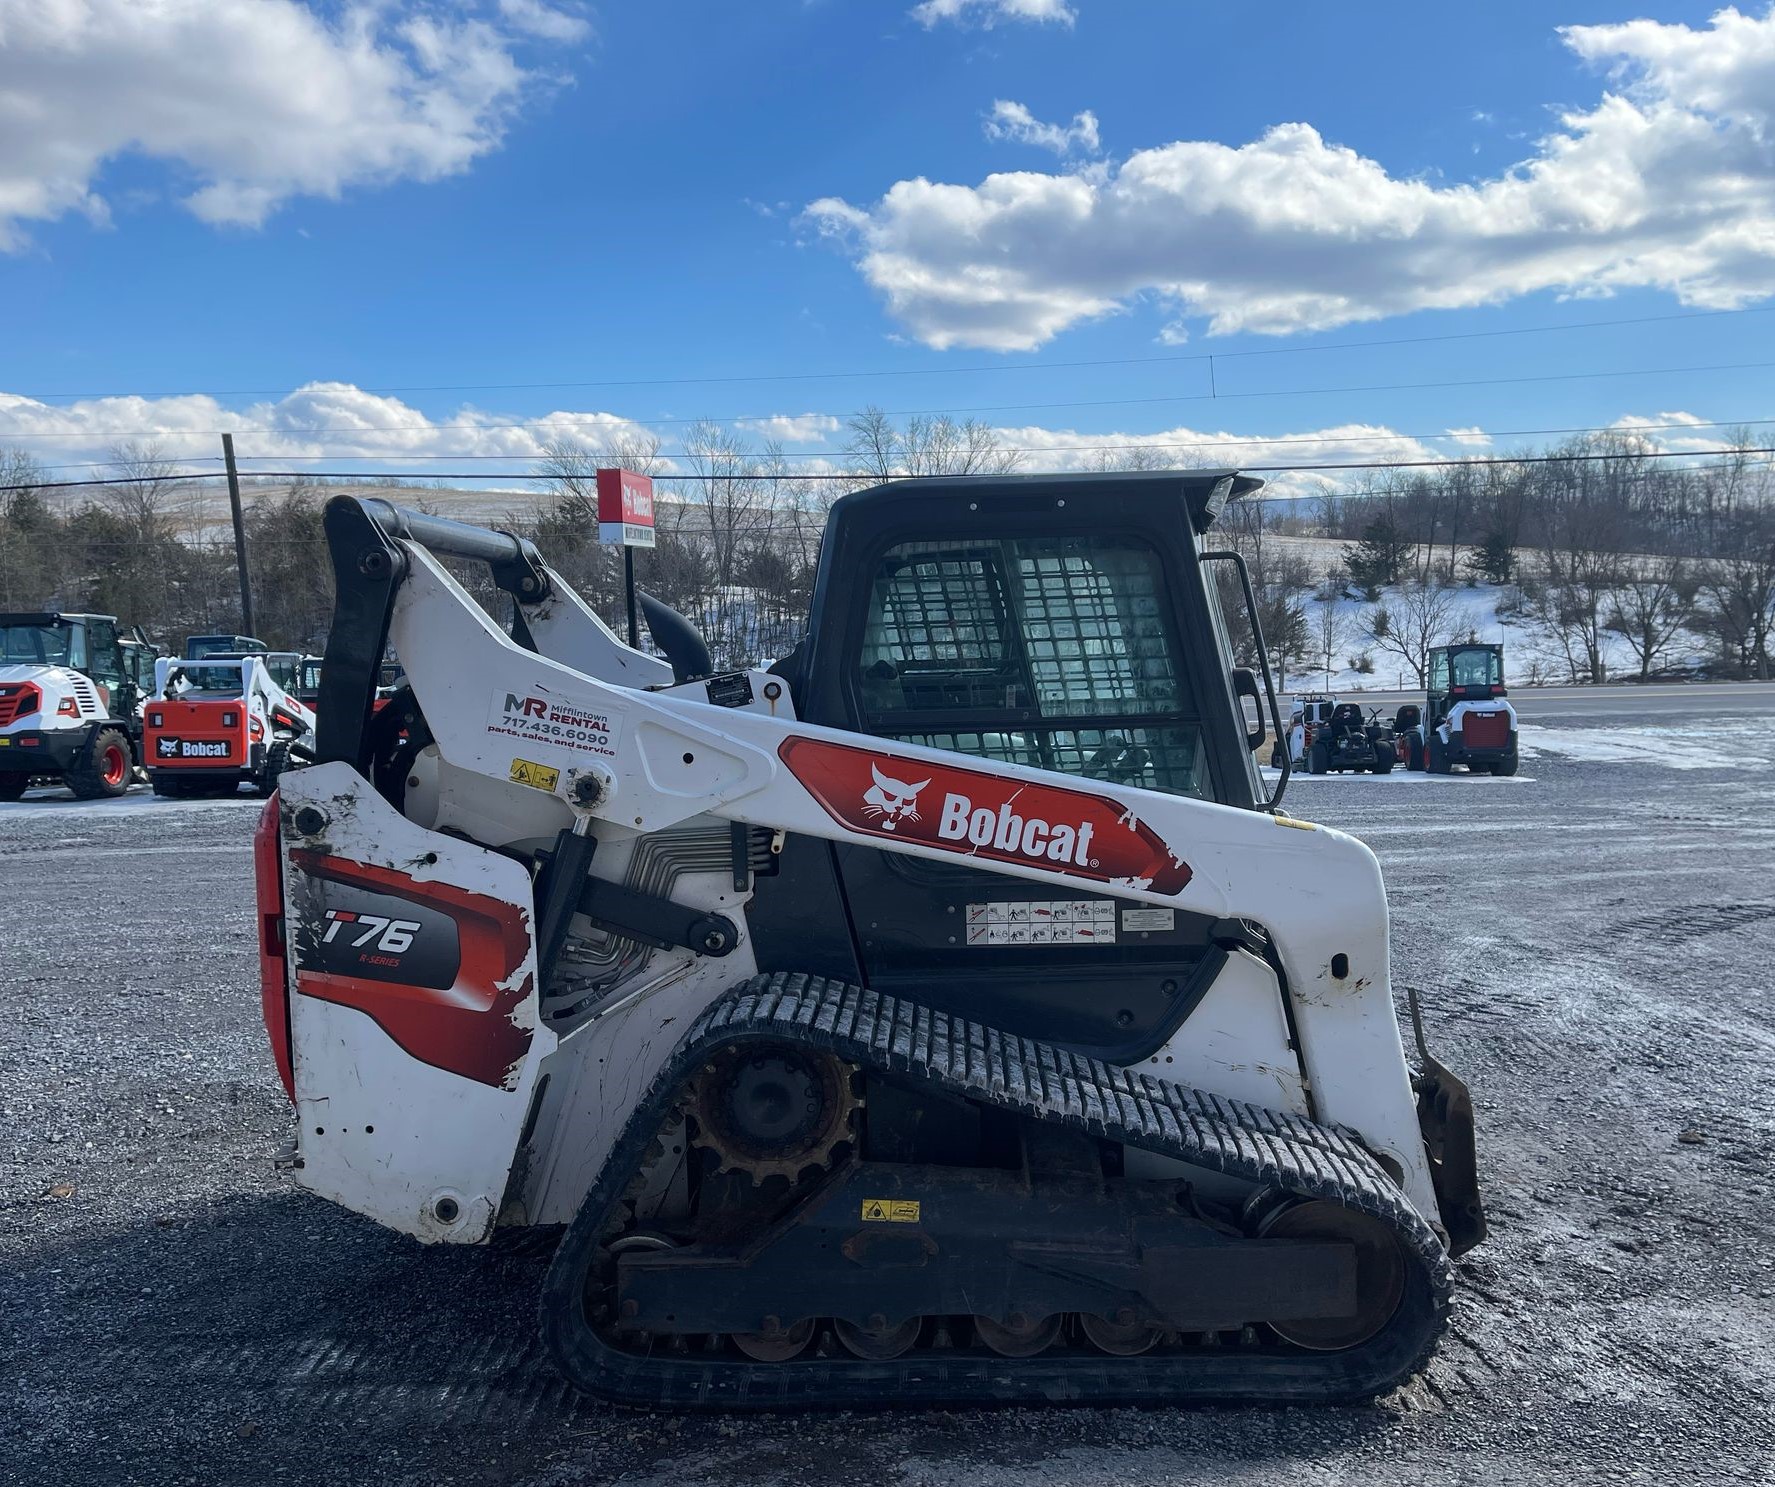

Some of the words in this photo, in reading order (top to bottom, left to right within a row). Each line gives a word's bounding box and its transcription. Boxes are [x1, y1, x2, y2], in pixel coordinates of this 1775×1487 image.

[504, 693, 548, 720] MR
[551, 704, 608, 722] Mifflintown
[502, 716, 608, 745] 717.436.6090
[549, 712, 610, 733] RENTAL
[182, 742, 226, 756] Bobcat
[487, 725, 520, 738] parts,
[522, 731, 552, 744] sales,
[554, 739, 575, 748] and
[576, 743, 615, 756] service
[938, 792, 1095, 867] Bobcat
[322, 910, 421, 953] T76
[359, 954, 400, 967] R-SERIES
